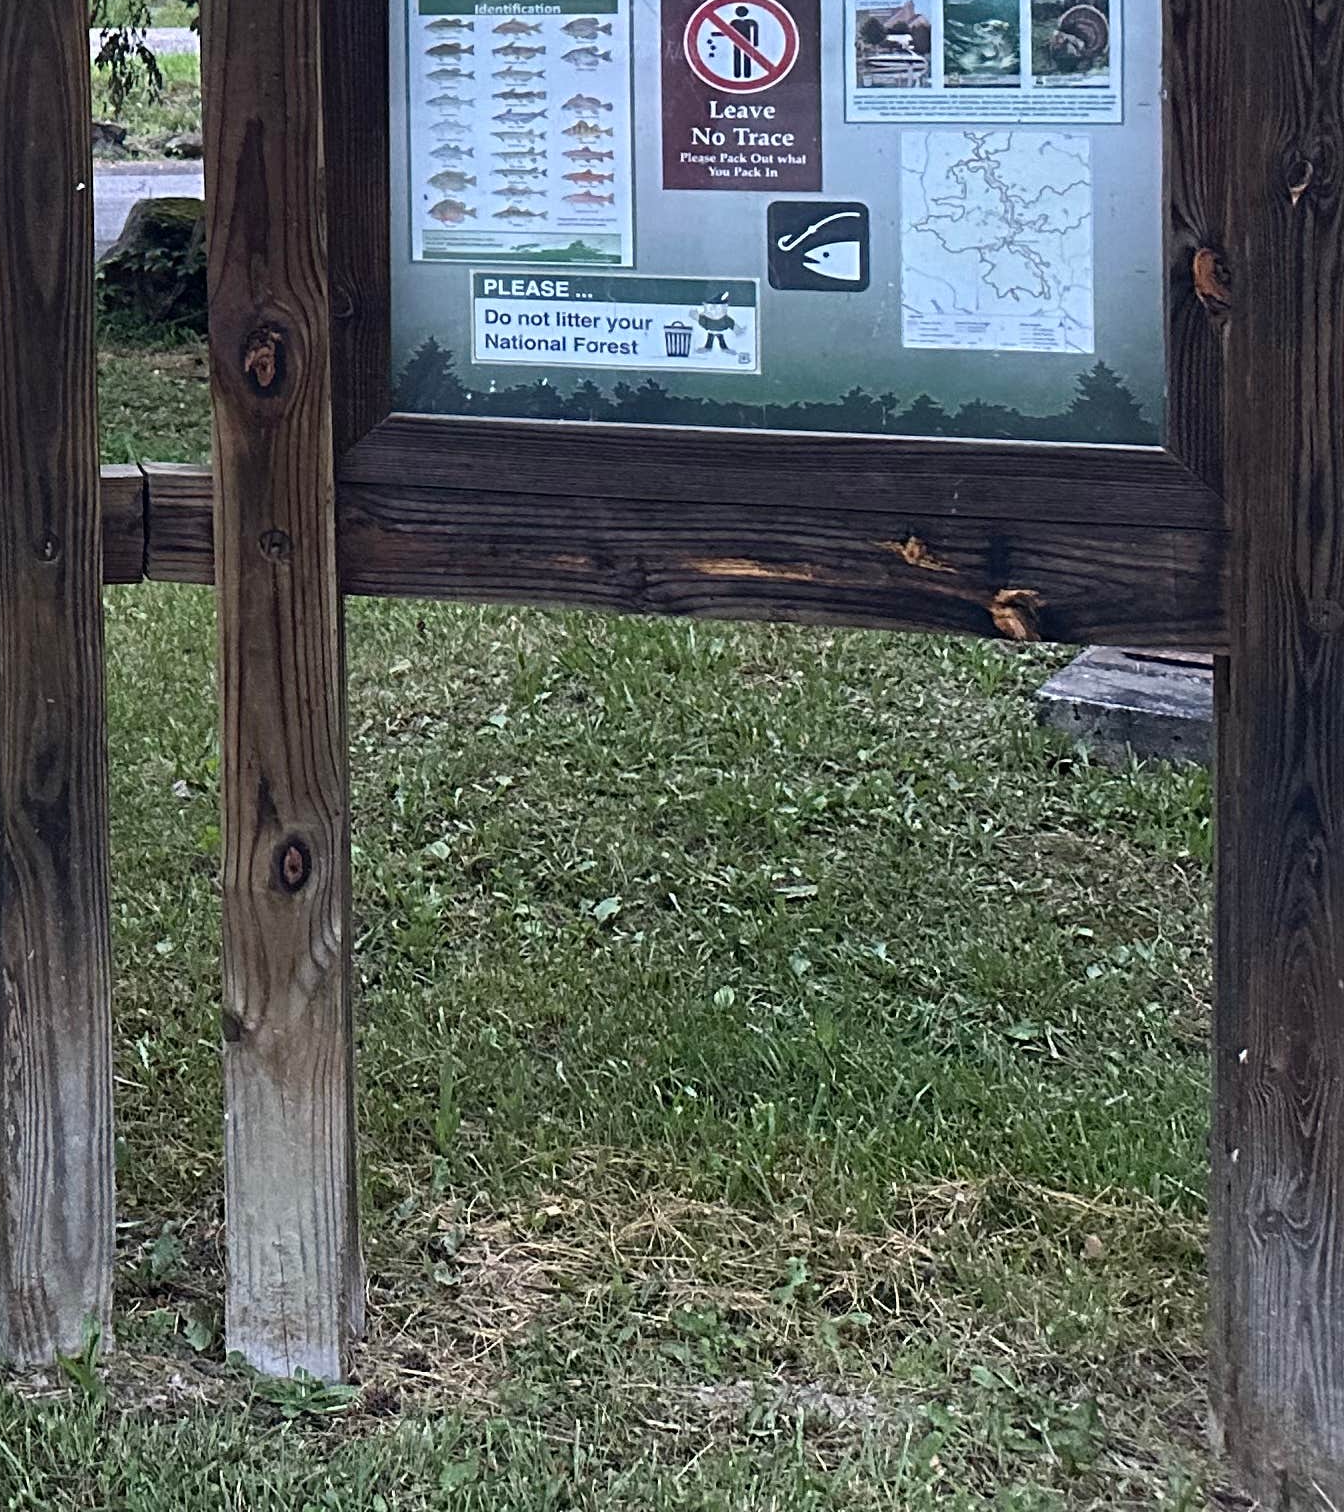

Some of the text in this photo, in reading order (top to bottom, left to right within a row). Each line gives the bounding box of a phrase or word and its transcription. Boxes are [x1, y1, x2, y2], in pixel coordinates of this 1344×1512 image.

[475, 4, 561, 15] Identification
[709, 100, 776, 119] Leave
[691, 127, 794, 147] No Trace
[680, 152, 806, 164] Please Pack Out what
[708, 166, 778, 177] You Pack In
[484, 279, 569, 298] PLEASE
[484, 309, 653, 333] Do not litter your
[485, 333, 638, 355] National Forest
